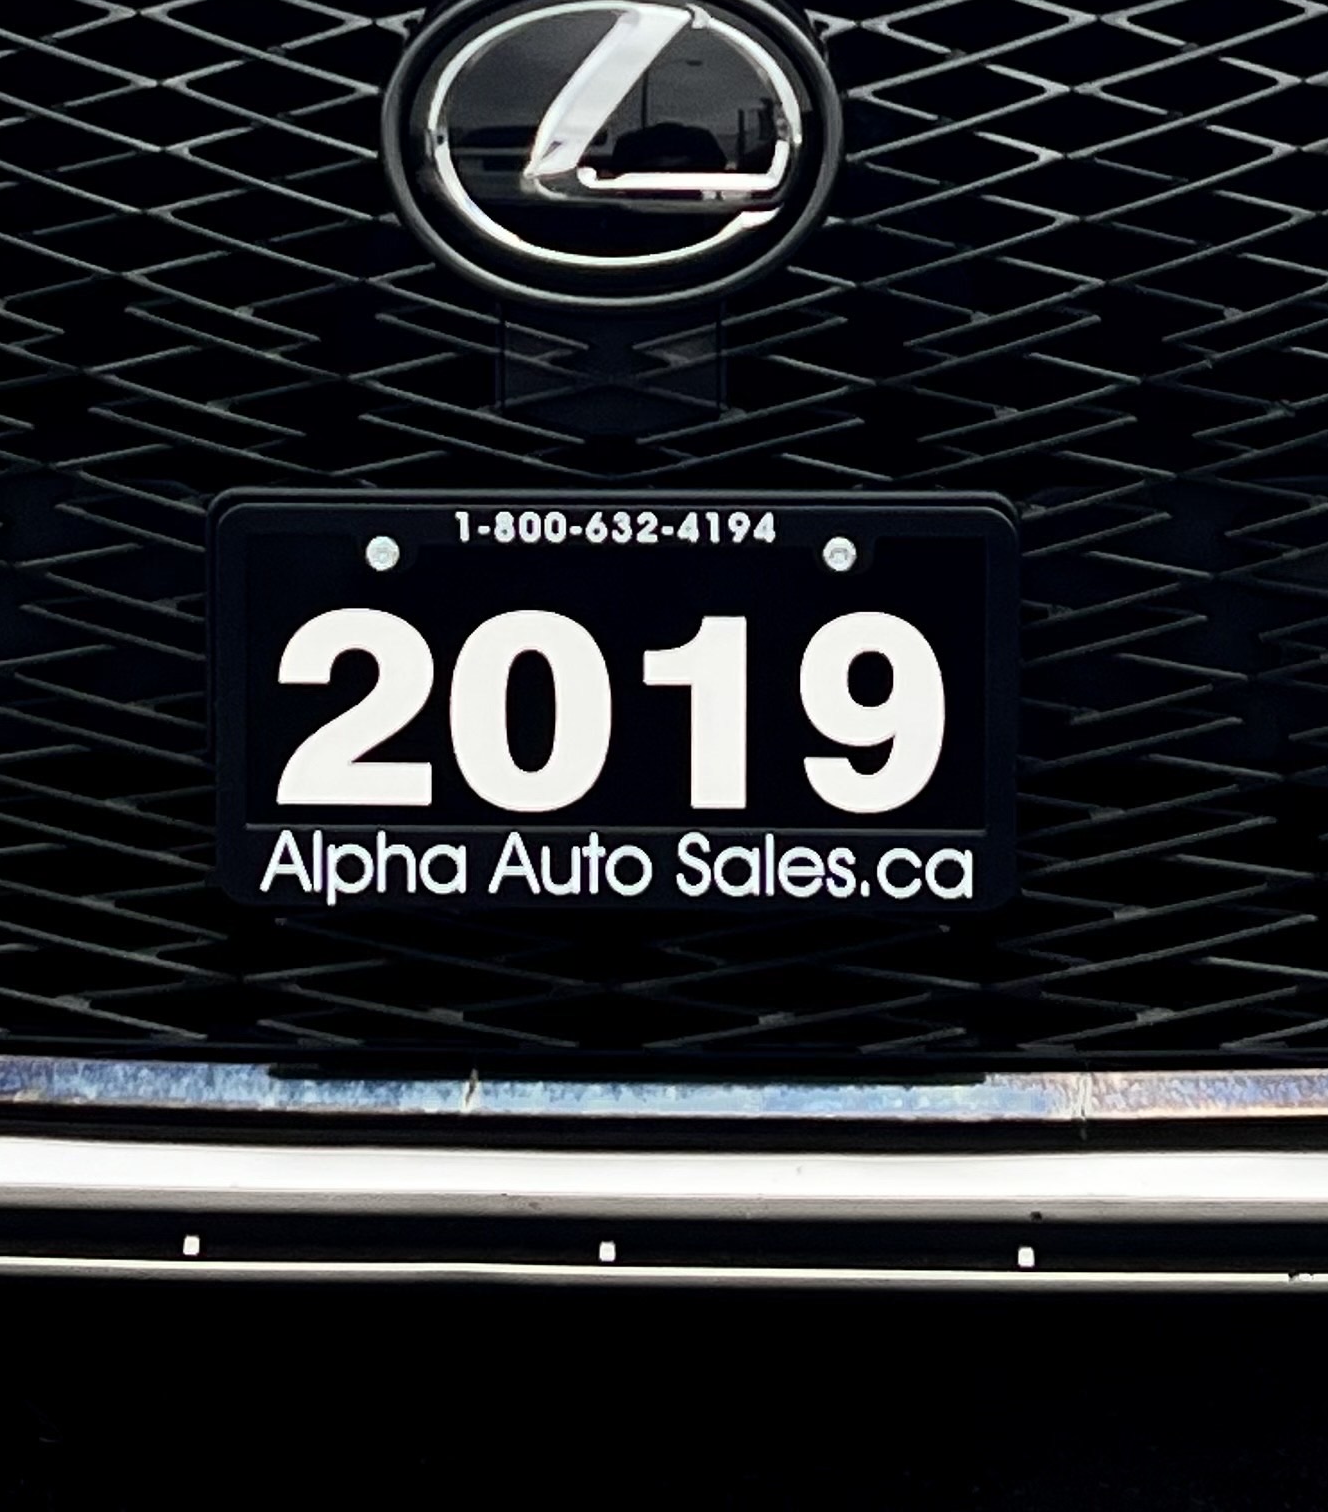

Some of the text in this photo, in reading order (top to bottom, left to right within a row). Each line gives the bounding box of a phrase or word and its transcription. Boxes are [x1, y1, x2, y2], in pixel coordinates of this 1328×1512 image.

[454, 511, 776, 544] 1-800-632-4194
[275, 607, 946, 814] 2019
[259, 829, 974, 906] Alpha Auto Sales.ca
